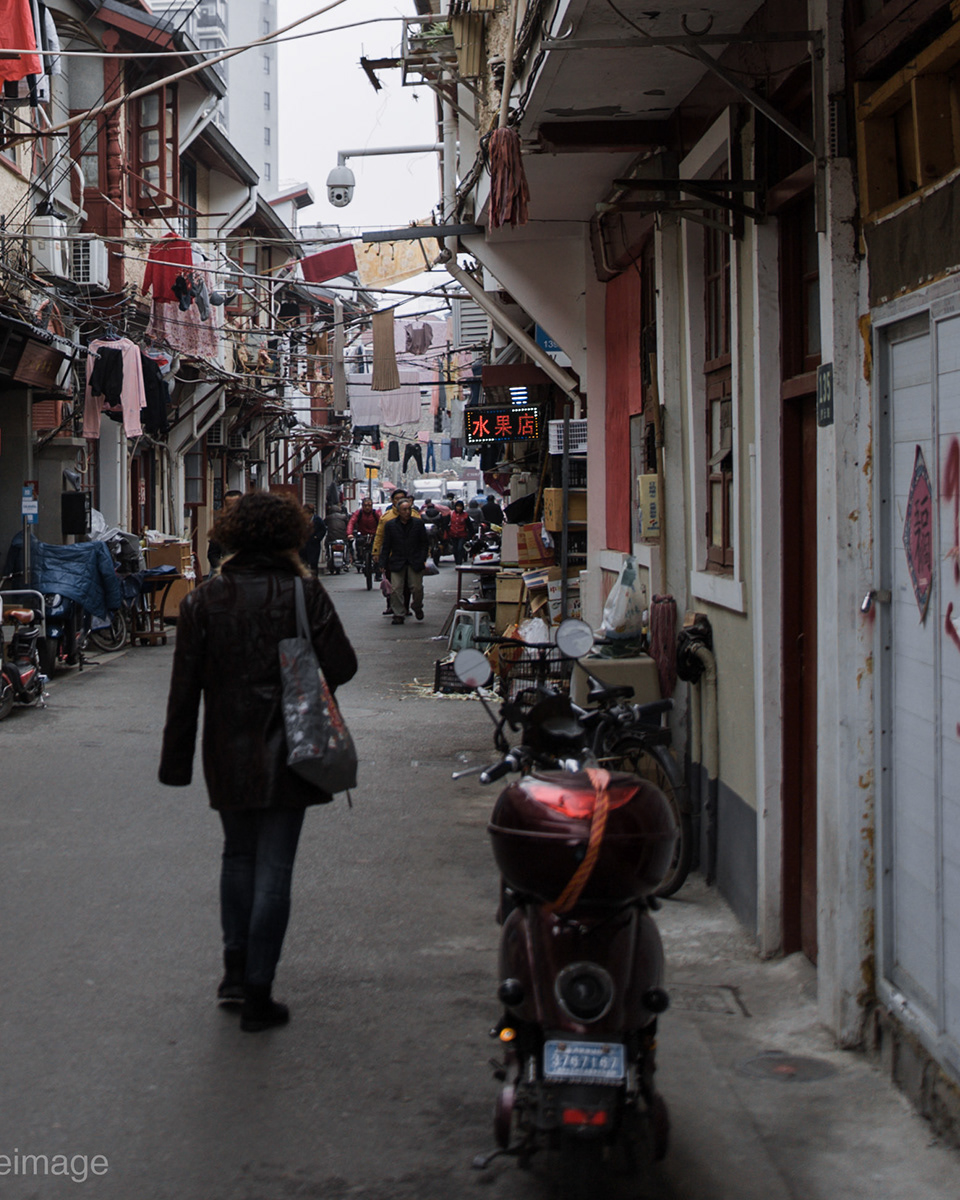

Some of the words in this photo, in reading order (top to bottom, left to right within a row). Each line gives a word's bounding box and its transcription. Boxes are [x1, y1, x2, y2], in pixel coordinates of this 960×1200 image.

[819, 371, 831, 404] 135
[472, 413, 534, 437] 水果店
